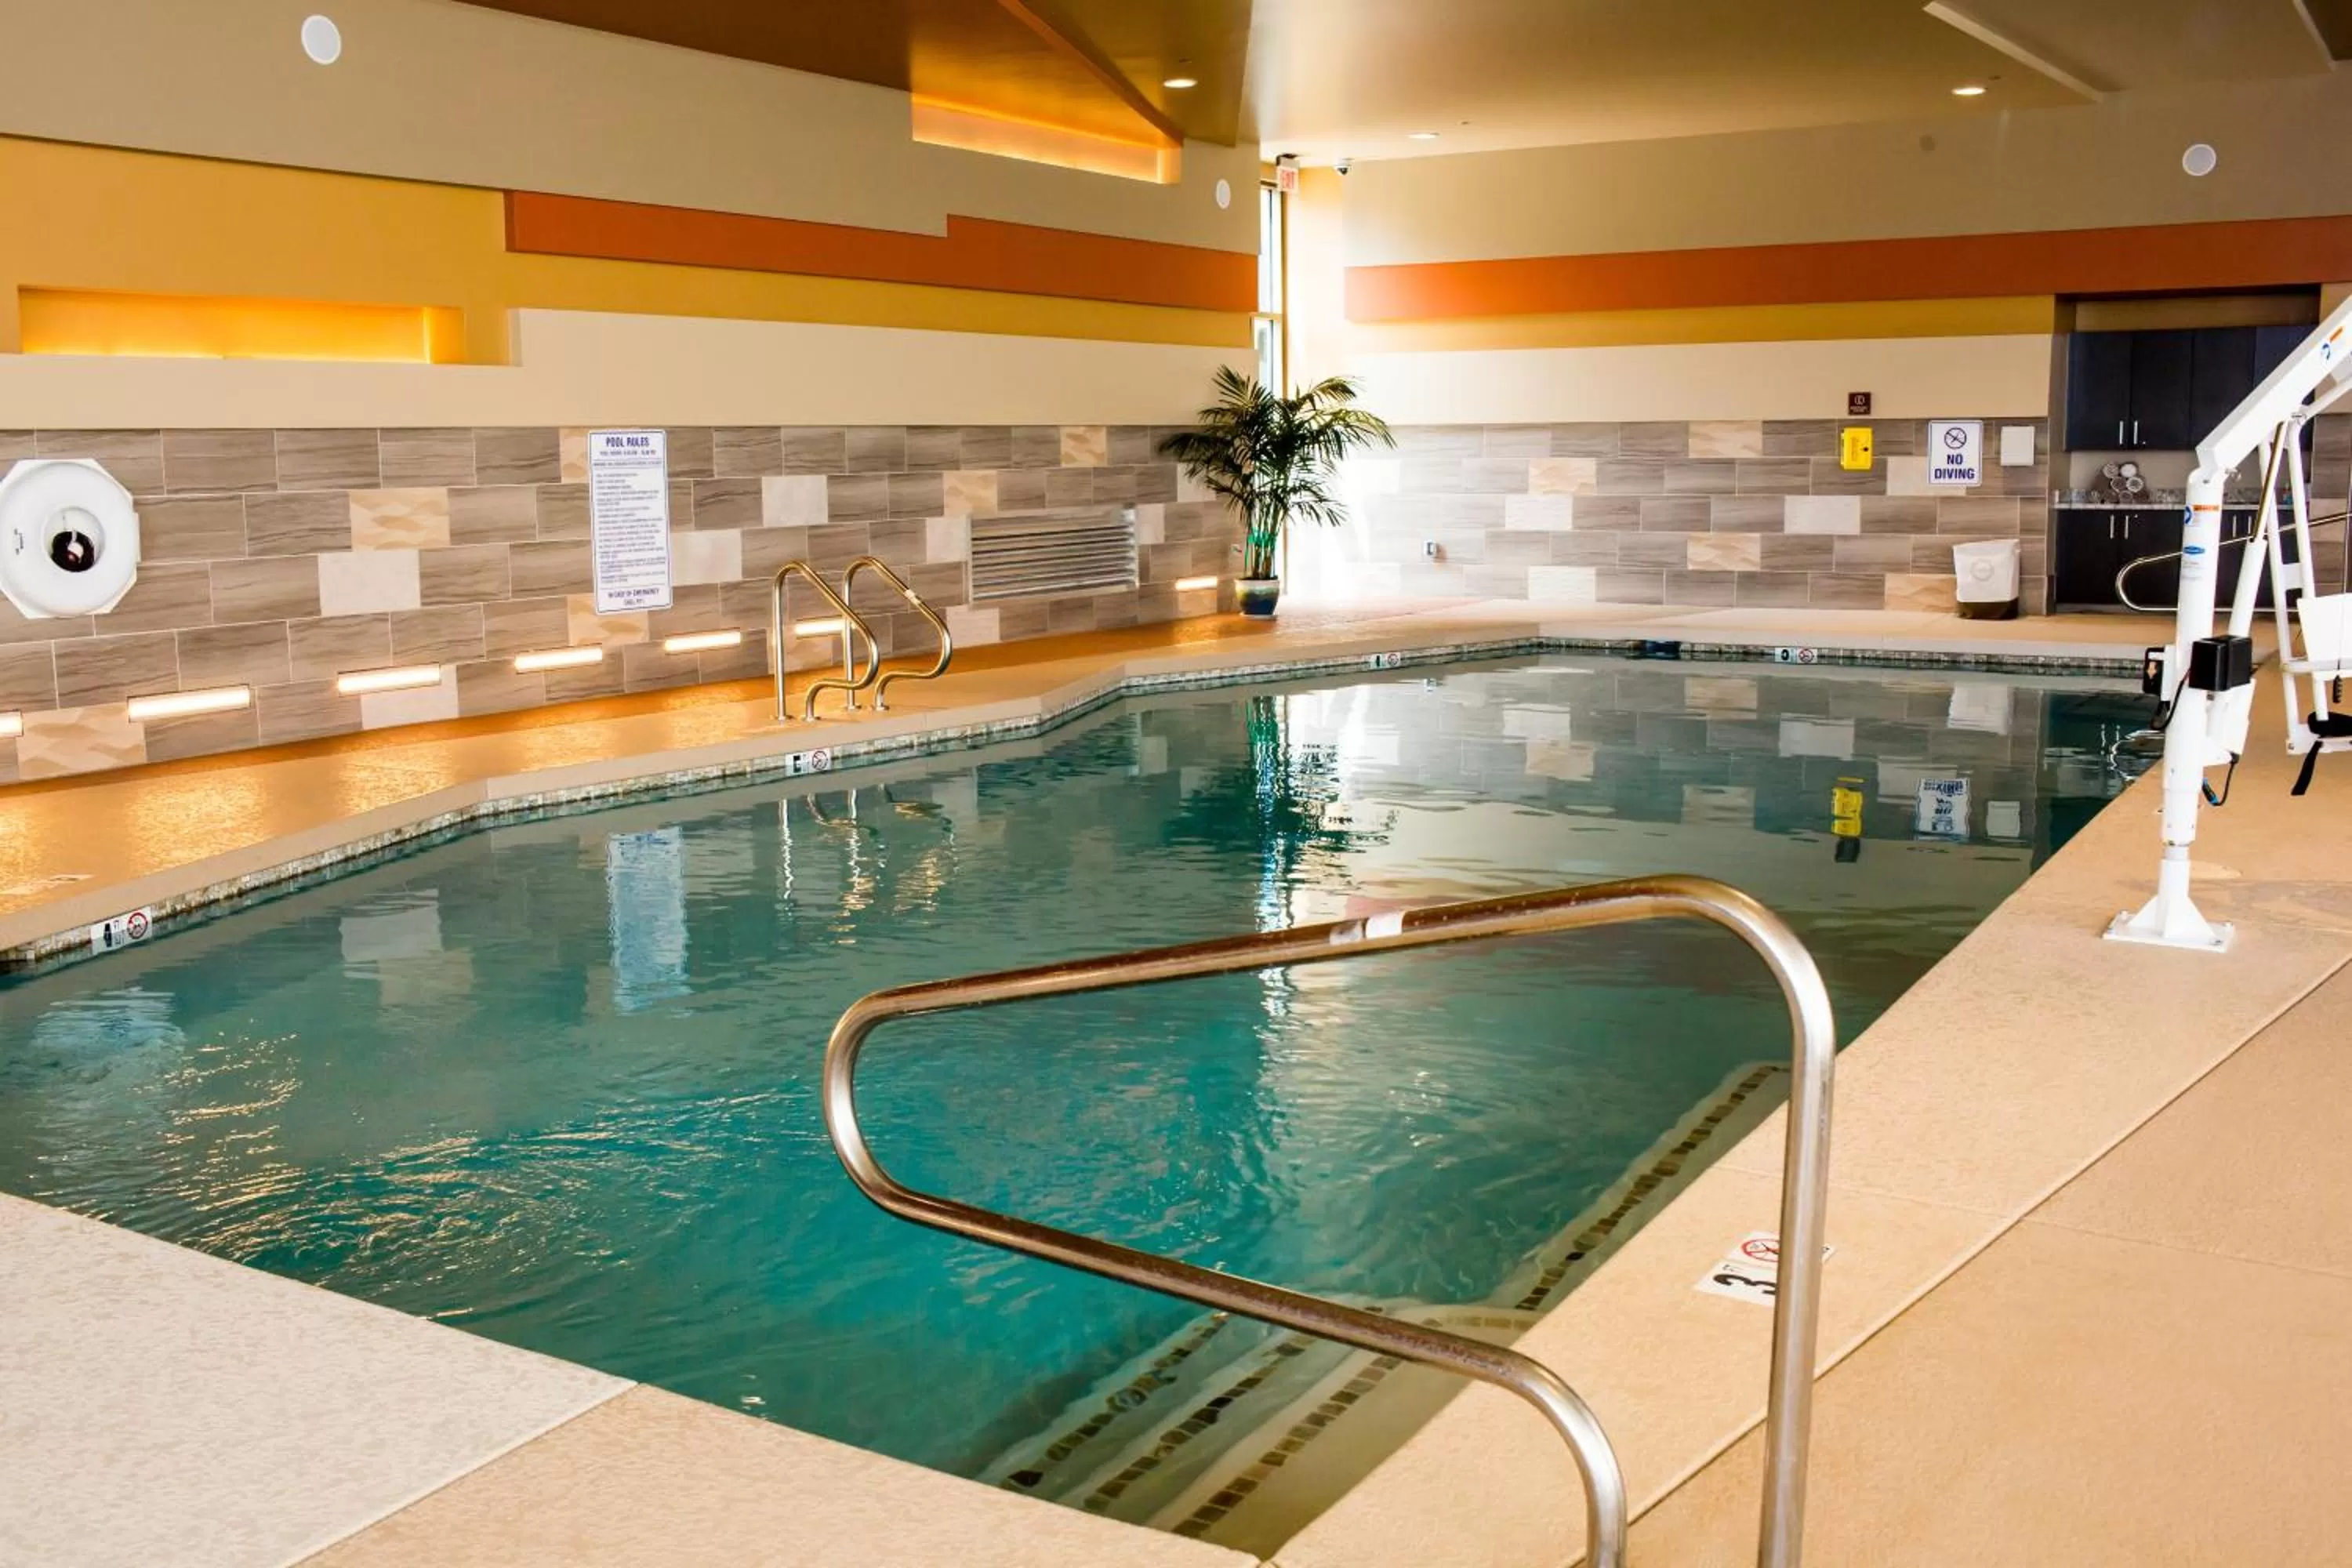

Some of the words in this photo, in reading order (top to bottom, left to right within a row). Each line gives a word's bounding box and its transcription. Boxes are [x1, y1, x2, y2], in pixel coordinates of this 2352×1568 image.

[606, 436, 624, 448] POOL
[626, 436, 650, 447] RULES
[1947, 453, 1964, 465] NO
[1934, 468, 1976, 480] DIVING
